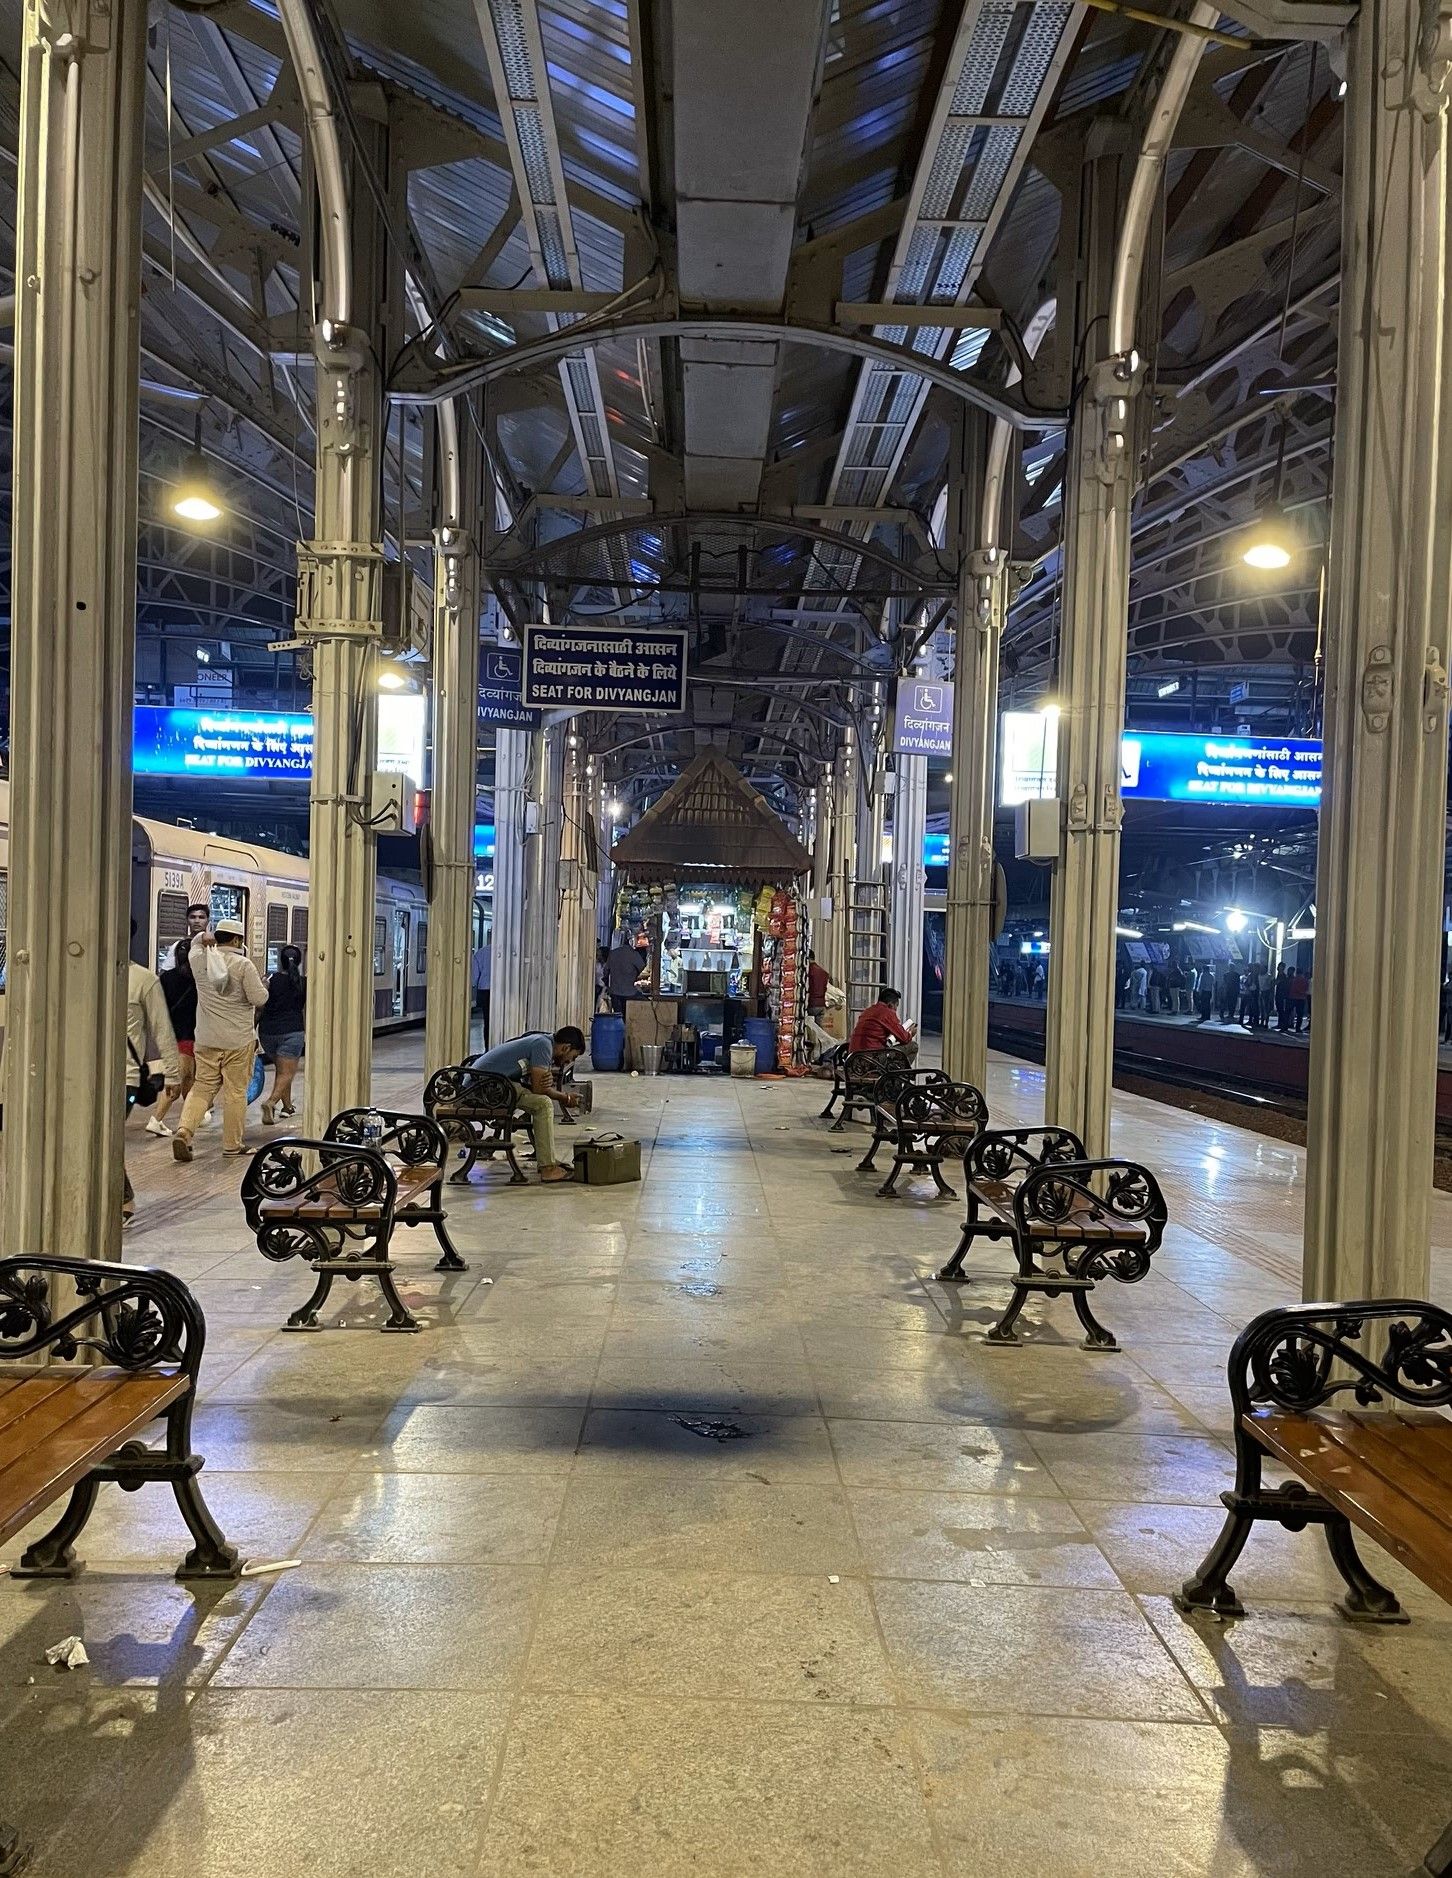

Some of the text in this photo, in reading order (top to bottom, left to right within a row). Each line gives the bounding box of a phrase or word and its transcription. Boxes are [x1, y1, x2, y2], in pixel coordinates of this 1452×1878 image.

[635, 642, 678, 656] आसन
[532, 657, 592, 677] दिव्यांगजन
[594, 660, 608, 677] के
[637, 662, 650, 679] के
[652, 663, 677, 680] लिये
[532, 684, 676, 703] SEAT FOR DIVYANGJAN
[904, 715, 950, 733] दिव्यांगजन
[900, 737, 951, 751] DIVYANGJAN
[476, 874, 495, 891] 12
